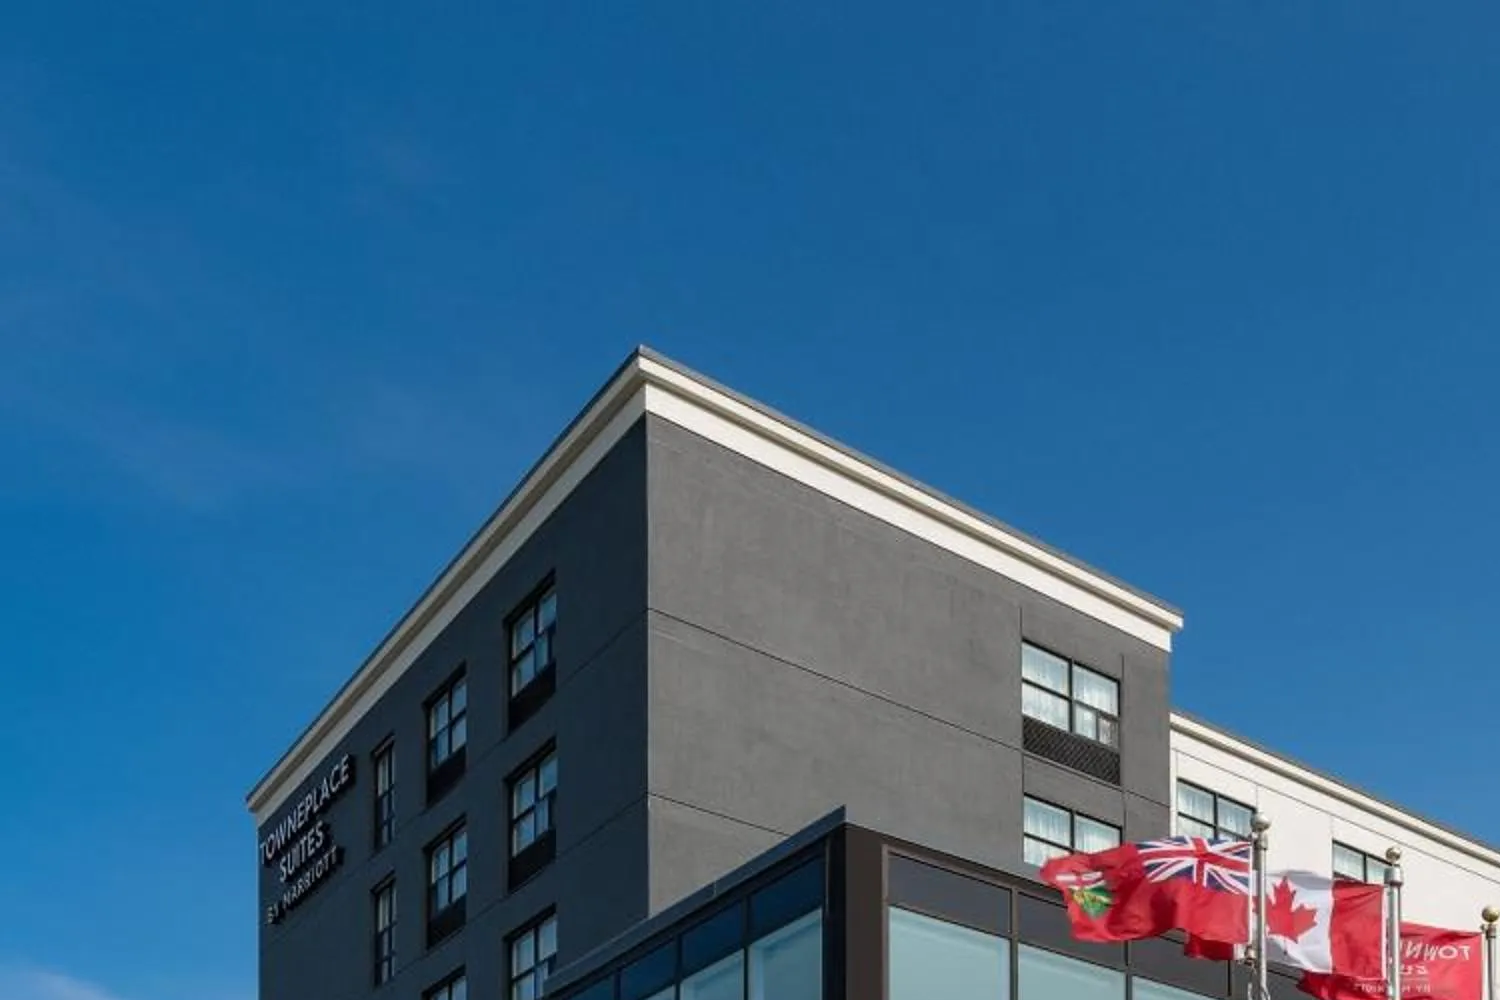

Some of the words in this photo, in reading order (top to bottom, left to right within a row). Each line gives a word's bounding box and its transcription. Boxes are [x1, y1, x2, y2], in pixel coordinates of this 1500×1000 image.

[260, 754, 350, 865] TOWNEPLACE
[267, 901, 280, 923] BY
[283, 845, 338, 909] MARRIOTT
[279, 820, 324, 883] SUITES
